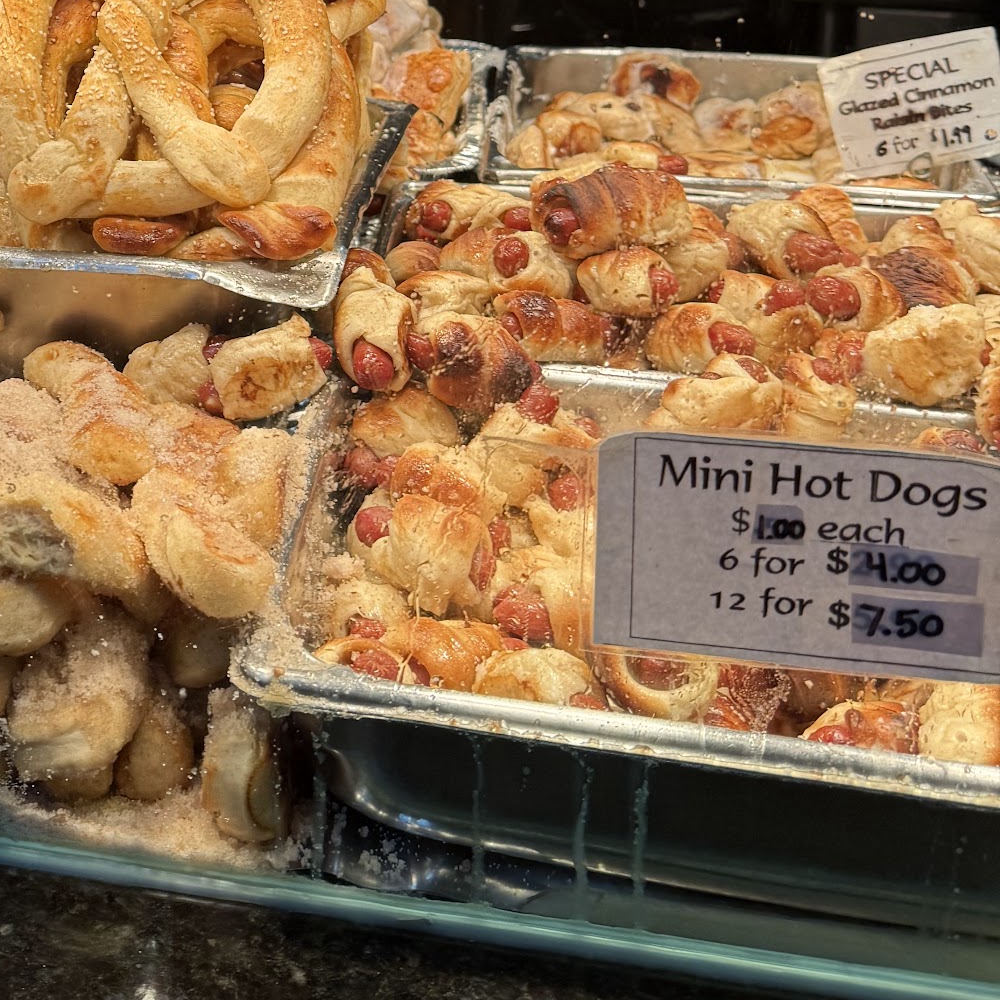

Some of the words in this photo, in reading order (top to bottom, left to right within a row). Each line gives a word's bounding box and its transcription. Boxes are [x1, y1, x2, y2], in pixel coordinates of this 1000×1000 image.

[864, 57, 960, 89] SPECIAL
[838, 92, 900, 116] Glazed
[904, 76, 996, 103] Cinnamon
[875, 140, 888, 157] 6
[892, 136, 919, 154] for
[658, 454, 753, 494] Mini
[770, 462, 853, 501] Hot
[868, 470, 988, 517] Dogs
[817, 517, 905, 546] each
[718, 547, 739, 571] 6
[750, 547, 806, 578] for
[710, 591, 746, 611] 12
[759, 586, 814, 618] for
